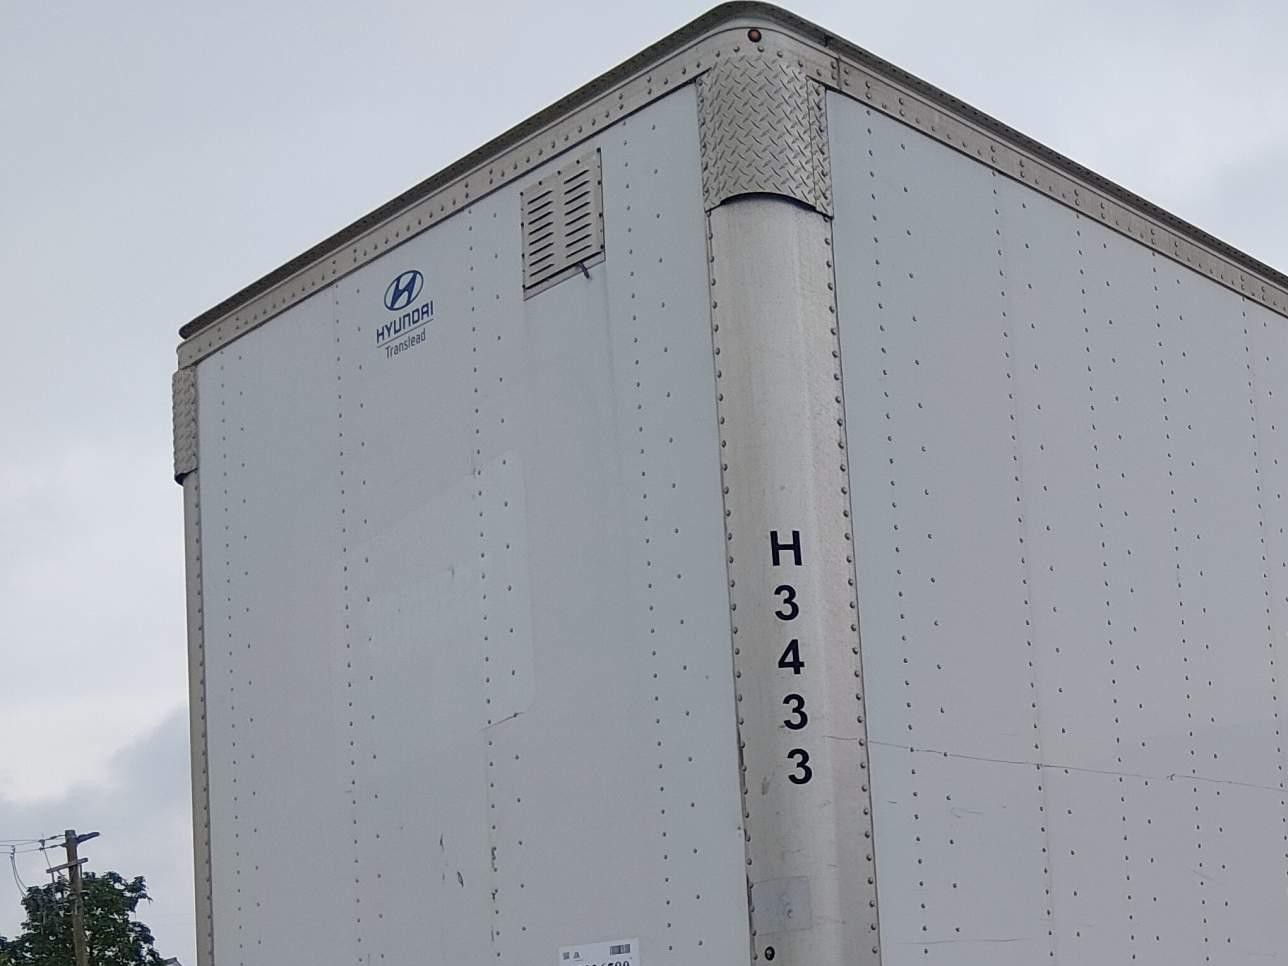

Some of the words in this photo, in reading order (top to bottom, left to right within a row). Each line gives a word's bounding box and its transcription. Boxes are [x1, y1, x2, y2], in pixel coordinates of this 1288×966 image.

[376, 300, 434, 344] HYUNDAI
[385, 327, 426, 359] Translead
[769, 530, 813, 785] H3433
